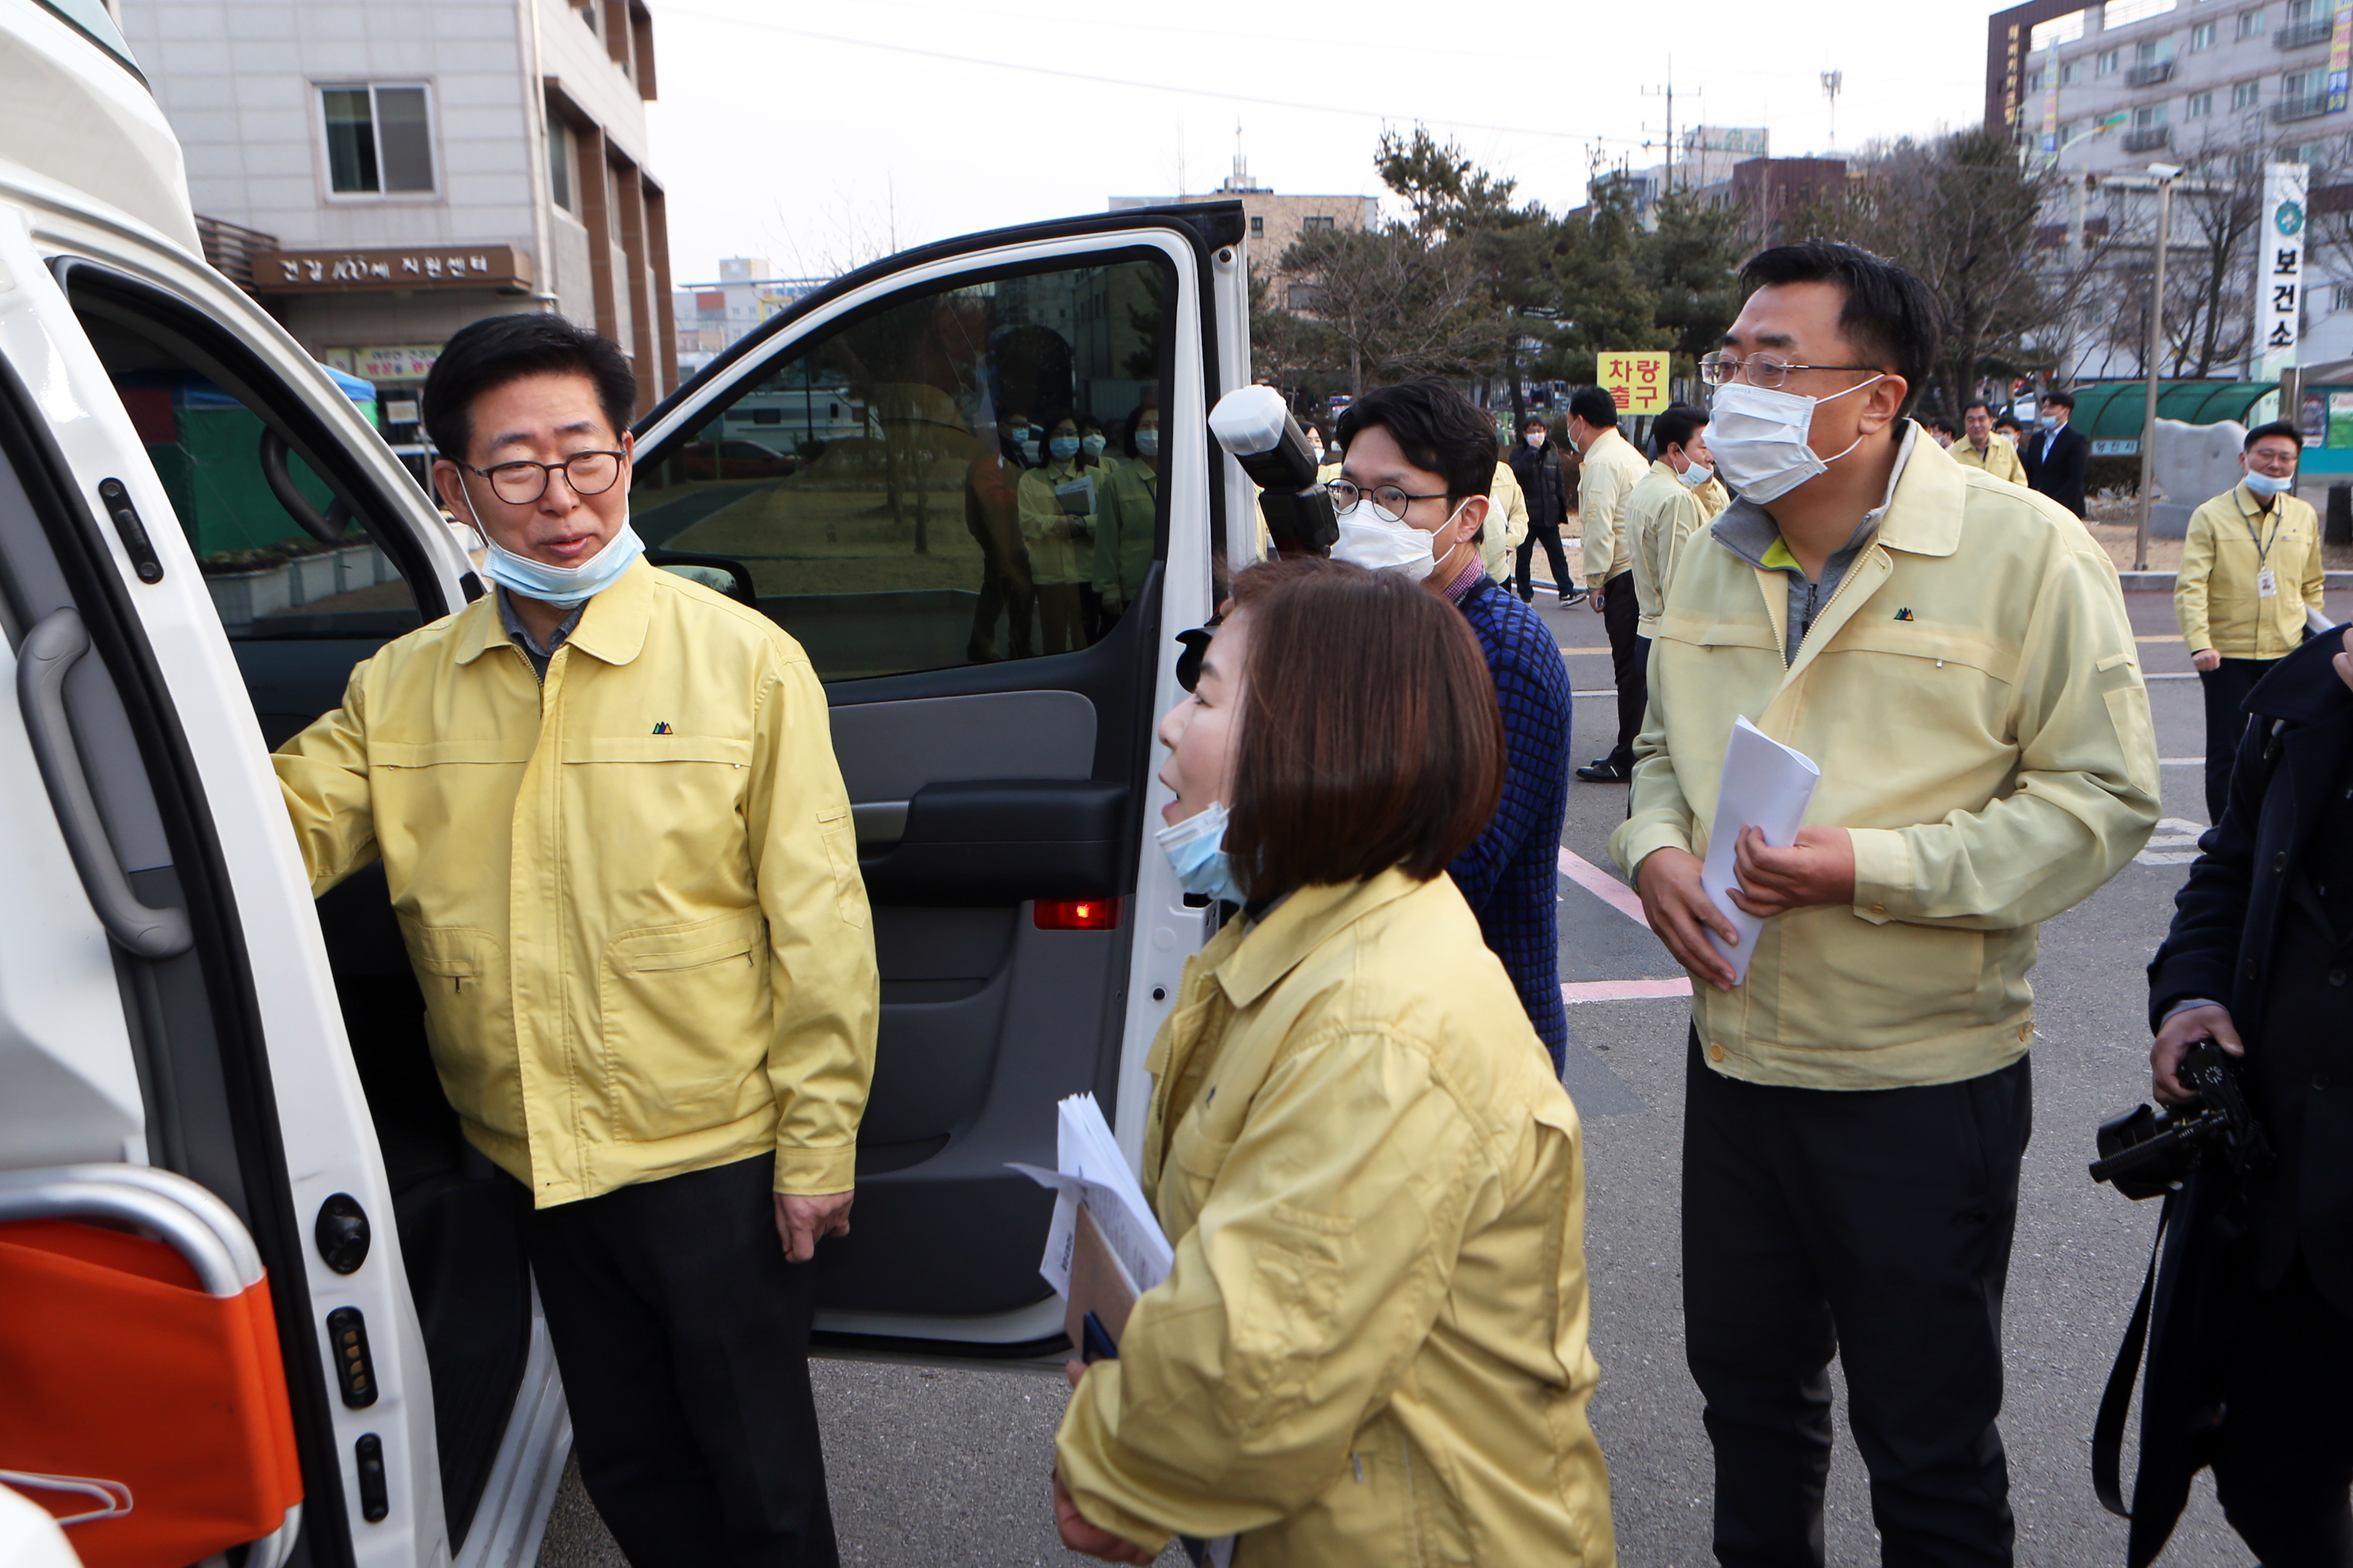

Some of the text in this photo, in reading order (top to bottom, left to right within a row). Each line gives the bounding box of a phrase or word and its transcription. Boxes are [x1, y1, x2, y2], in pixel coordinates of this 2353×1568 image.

[279, 259, 323, 283] 건강
[401, 256, 488, 279] 지원센터
[2268, 248, 2298, 346] 보건소
[1608, 359, 1660, 383] 차량
[1609, 385, 1658, 409] 출구
